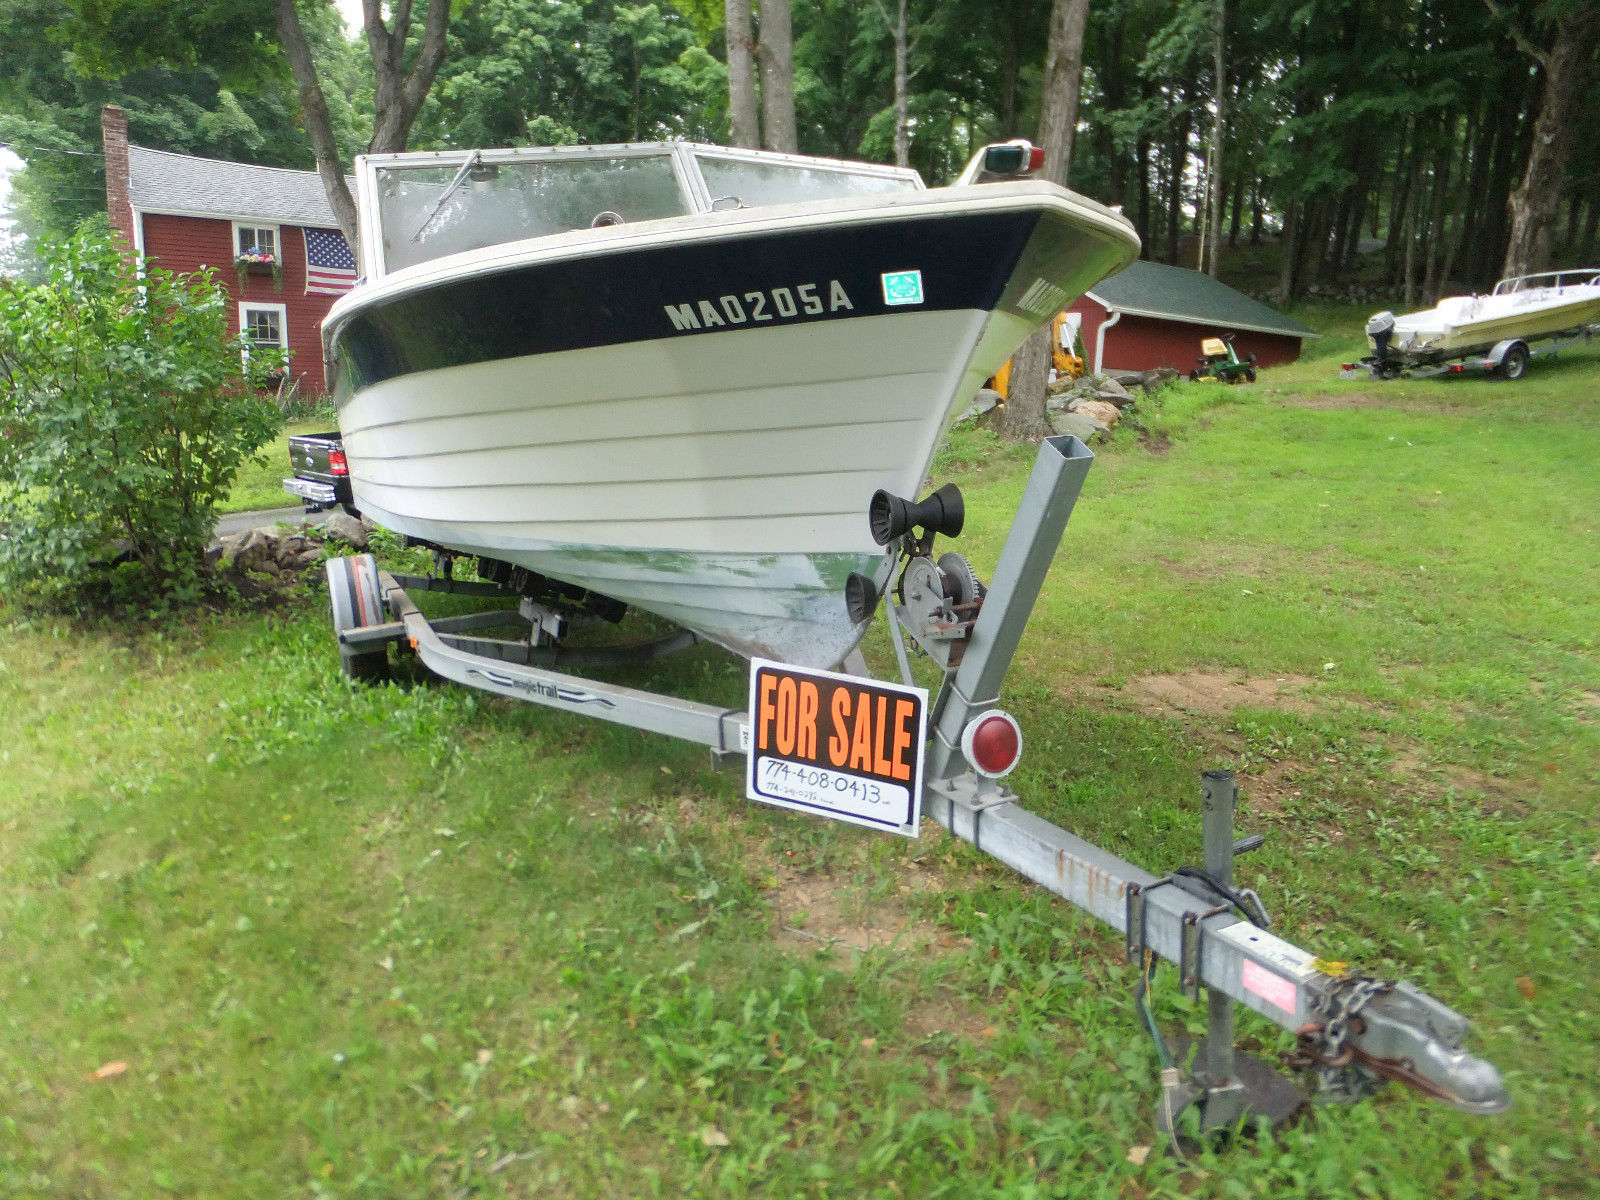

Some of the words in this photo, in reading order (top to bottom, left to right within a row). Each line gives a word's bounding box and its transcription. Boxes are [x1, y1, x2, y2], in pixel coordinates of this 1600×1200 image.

[759, 674, 819, 760] FOR
[828, 686, 914, 780] SALE
[765, 760, 881, 804] 774-408-0413
